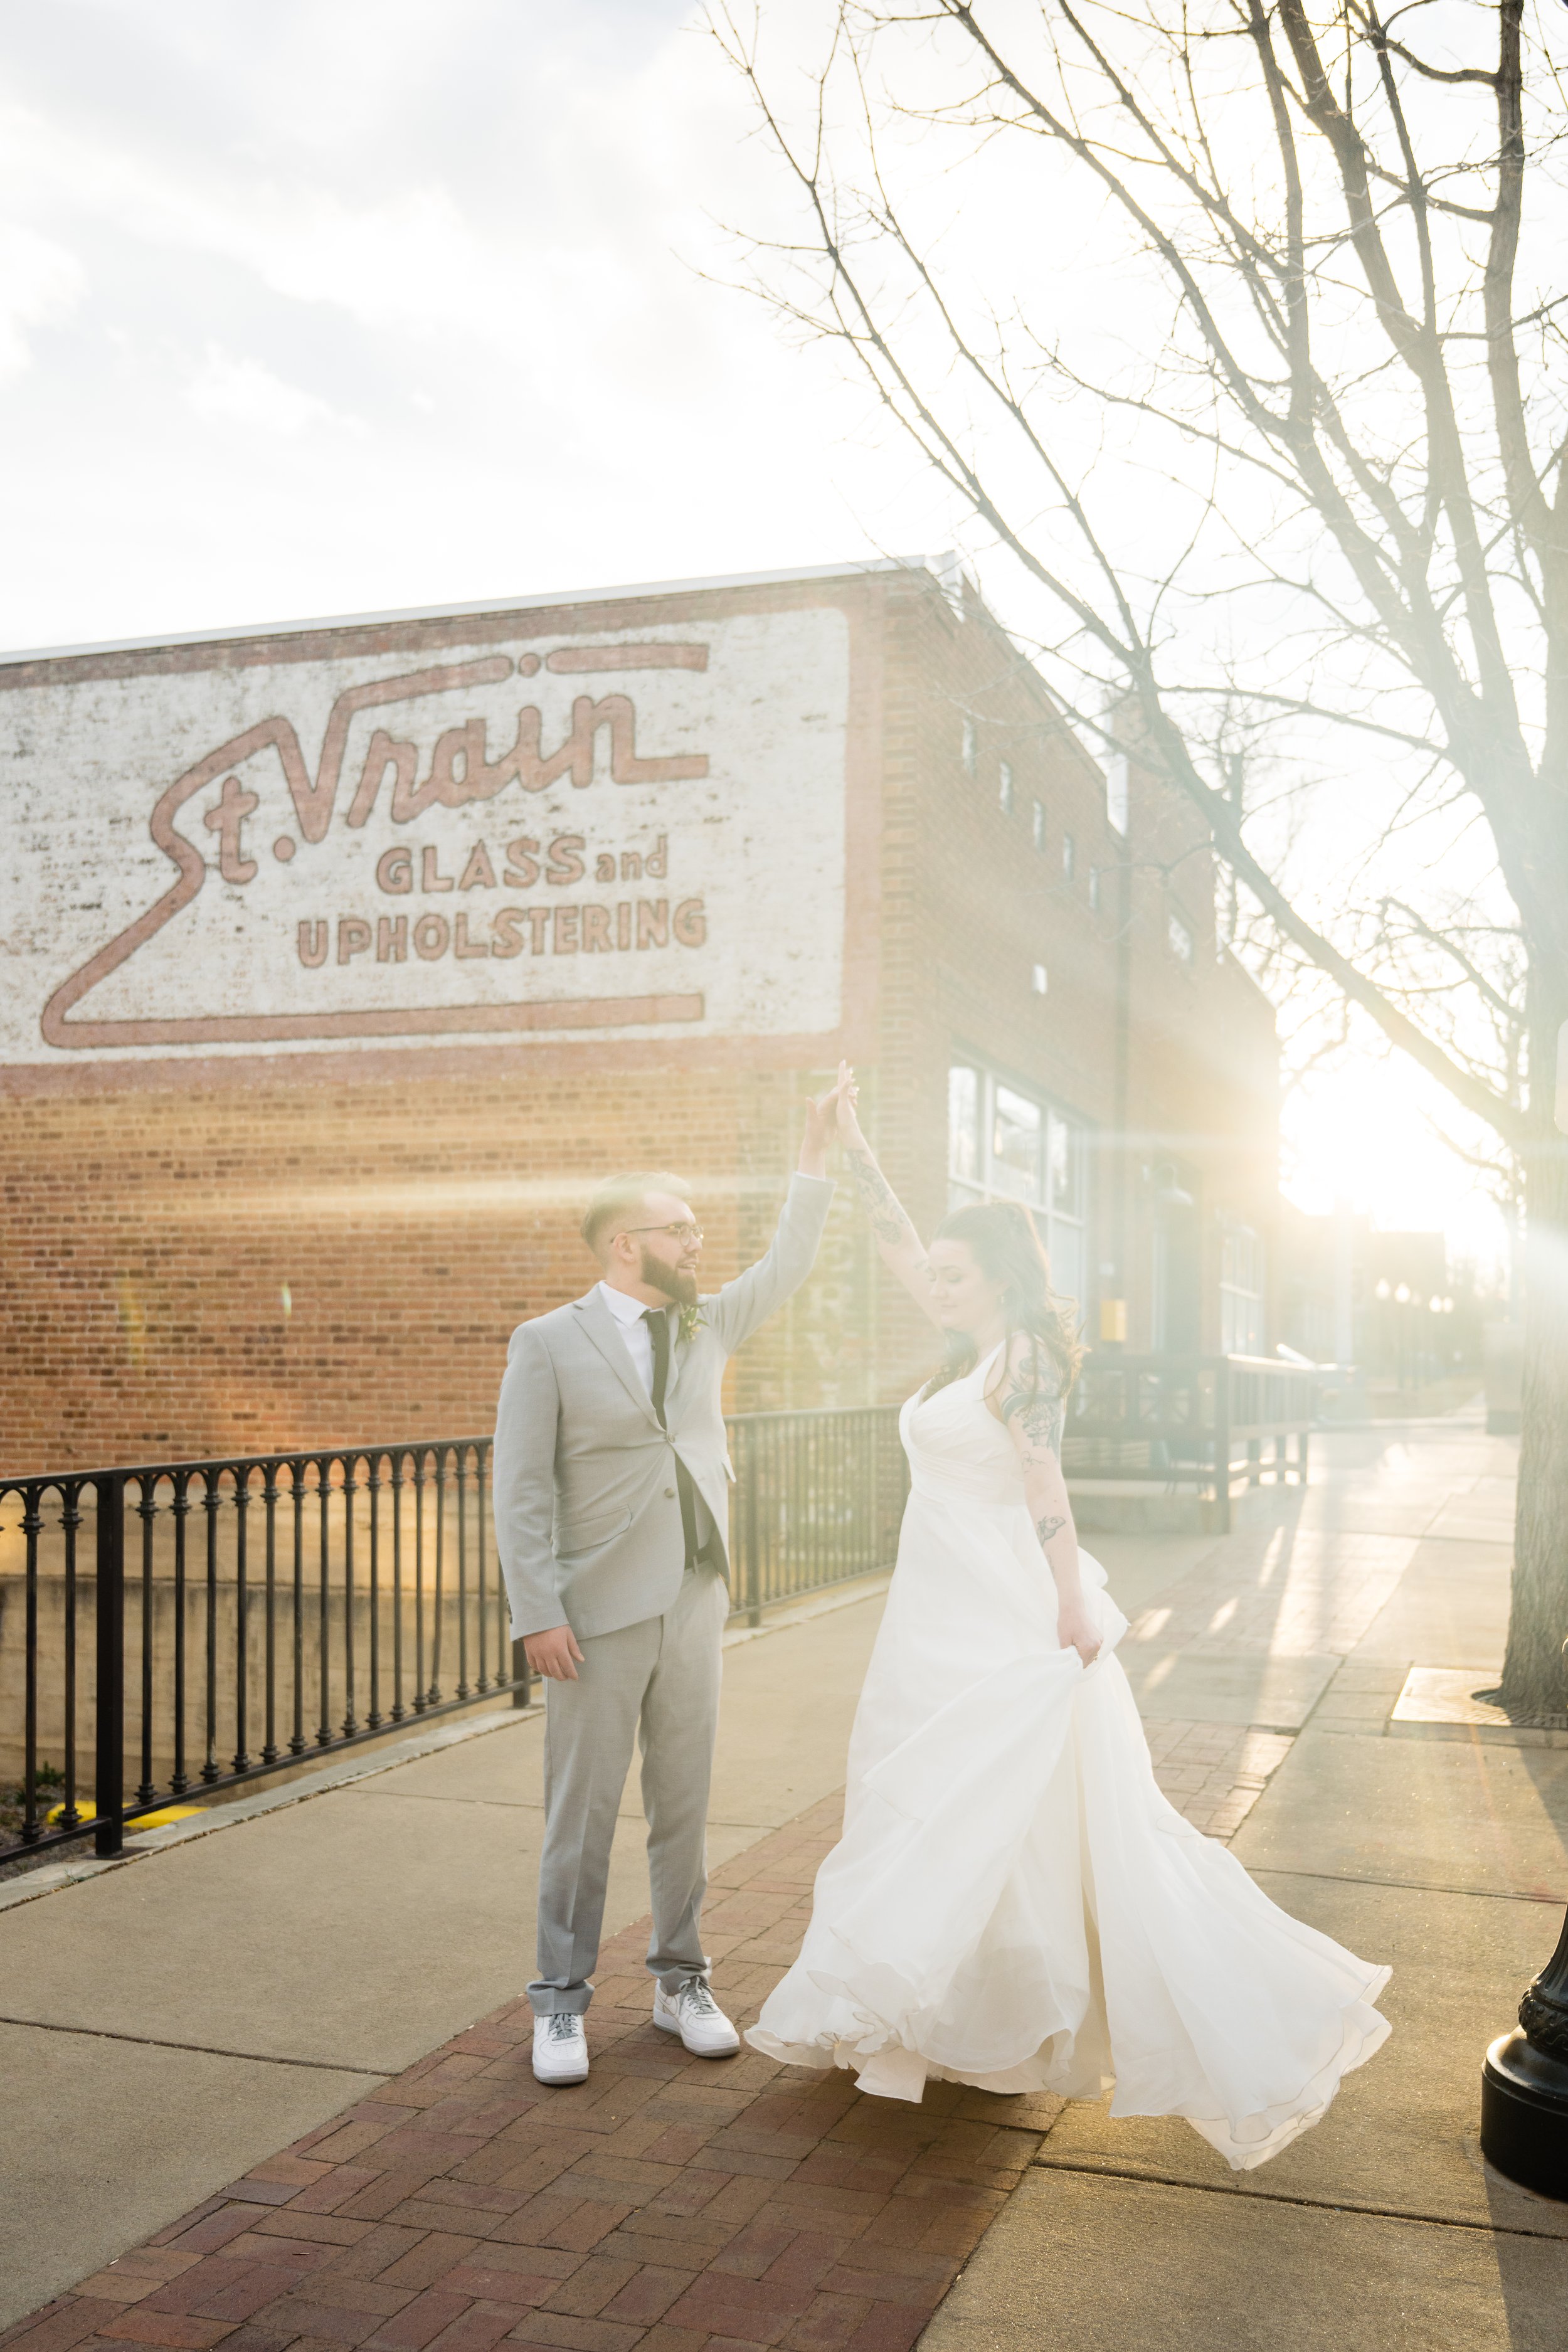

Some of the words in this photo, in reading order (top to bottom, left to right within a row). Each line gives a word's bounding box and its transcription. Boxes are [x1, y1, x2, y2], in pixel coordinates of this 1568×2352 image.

[273, 652, 709, 844] Vrain
[376, 834, 586, 895] GLASS
[595, 833, 669, 882] and
[297, 898, 707, 968] UPHOLSTERING
